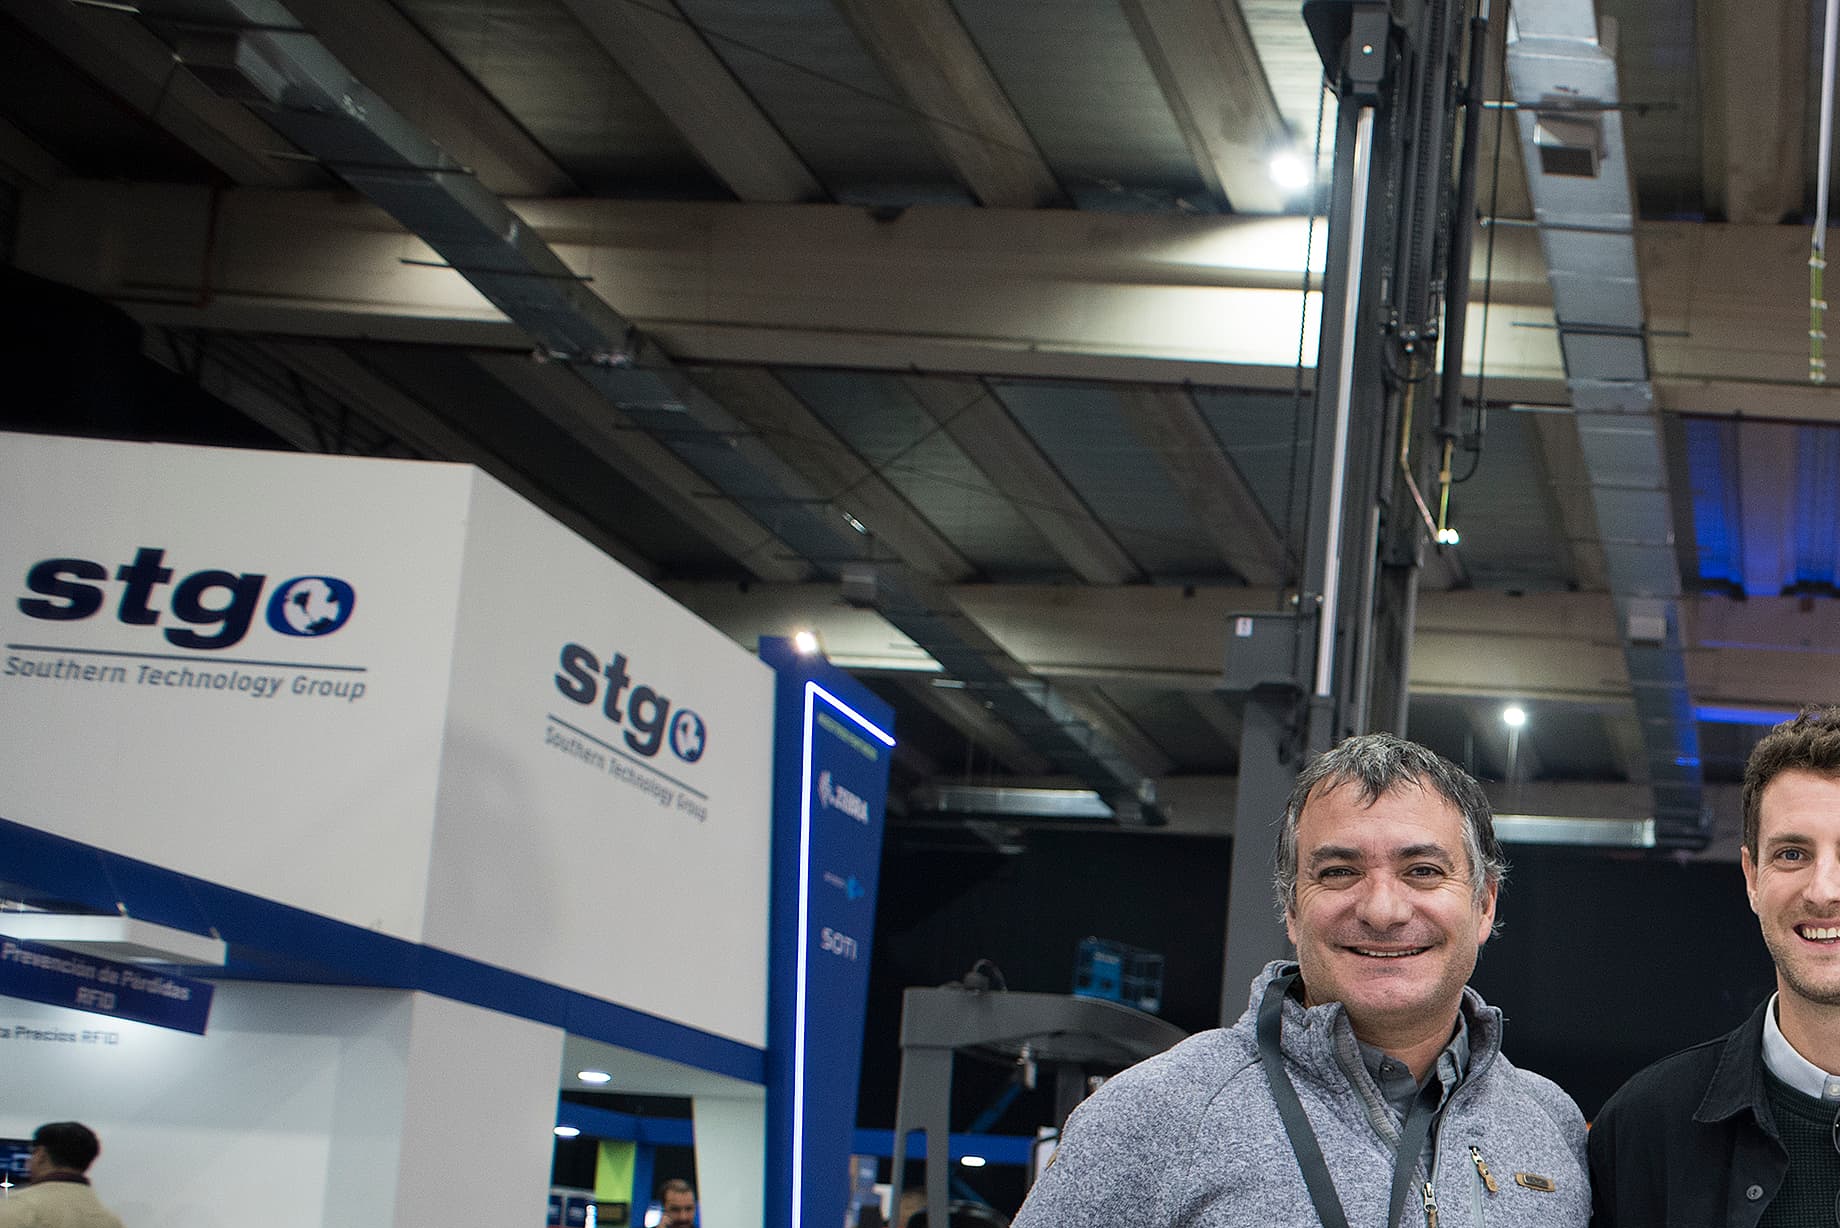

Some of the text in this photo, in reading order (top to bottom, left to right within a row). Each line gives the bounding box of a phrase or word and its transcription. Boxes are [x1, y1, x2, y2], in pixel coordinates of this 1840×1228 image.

[17, 547, 357, 650] stgo
[3, 656, 367, 703] Southern Technology Group
[554, 642, 708, 765] stgo
[545, 726, 708, 823] Southern Technology Group
[820, 926, 858, 961] SOTI
